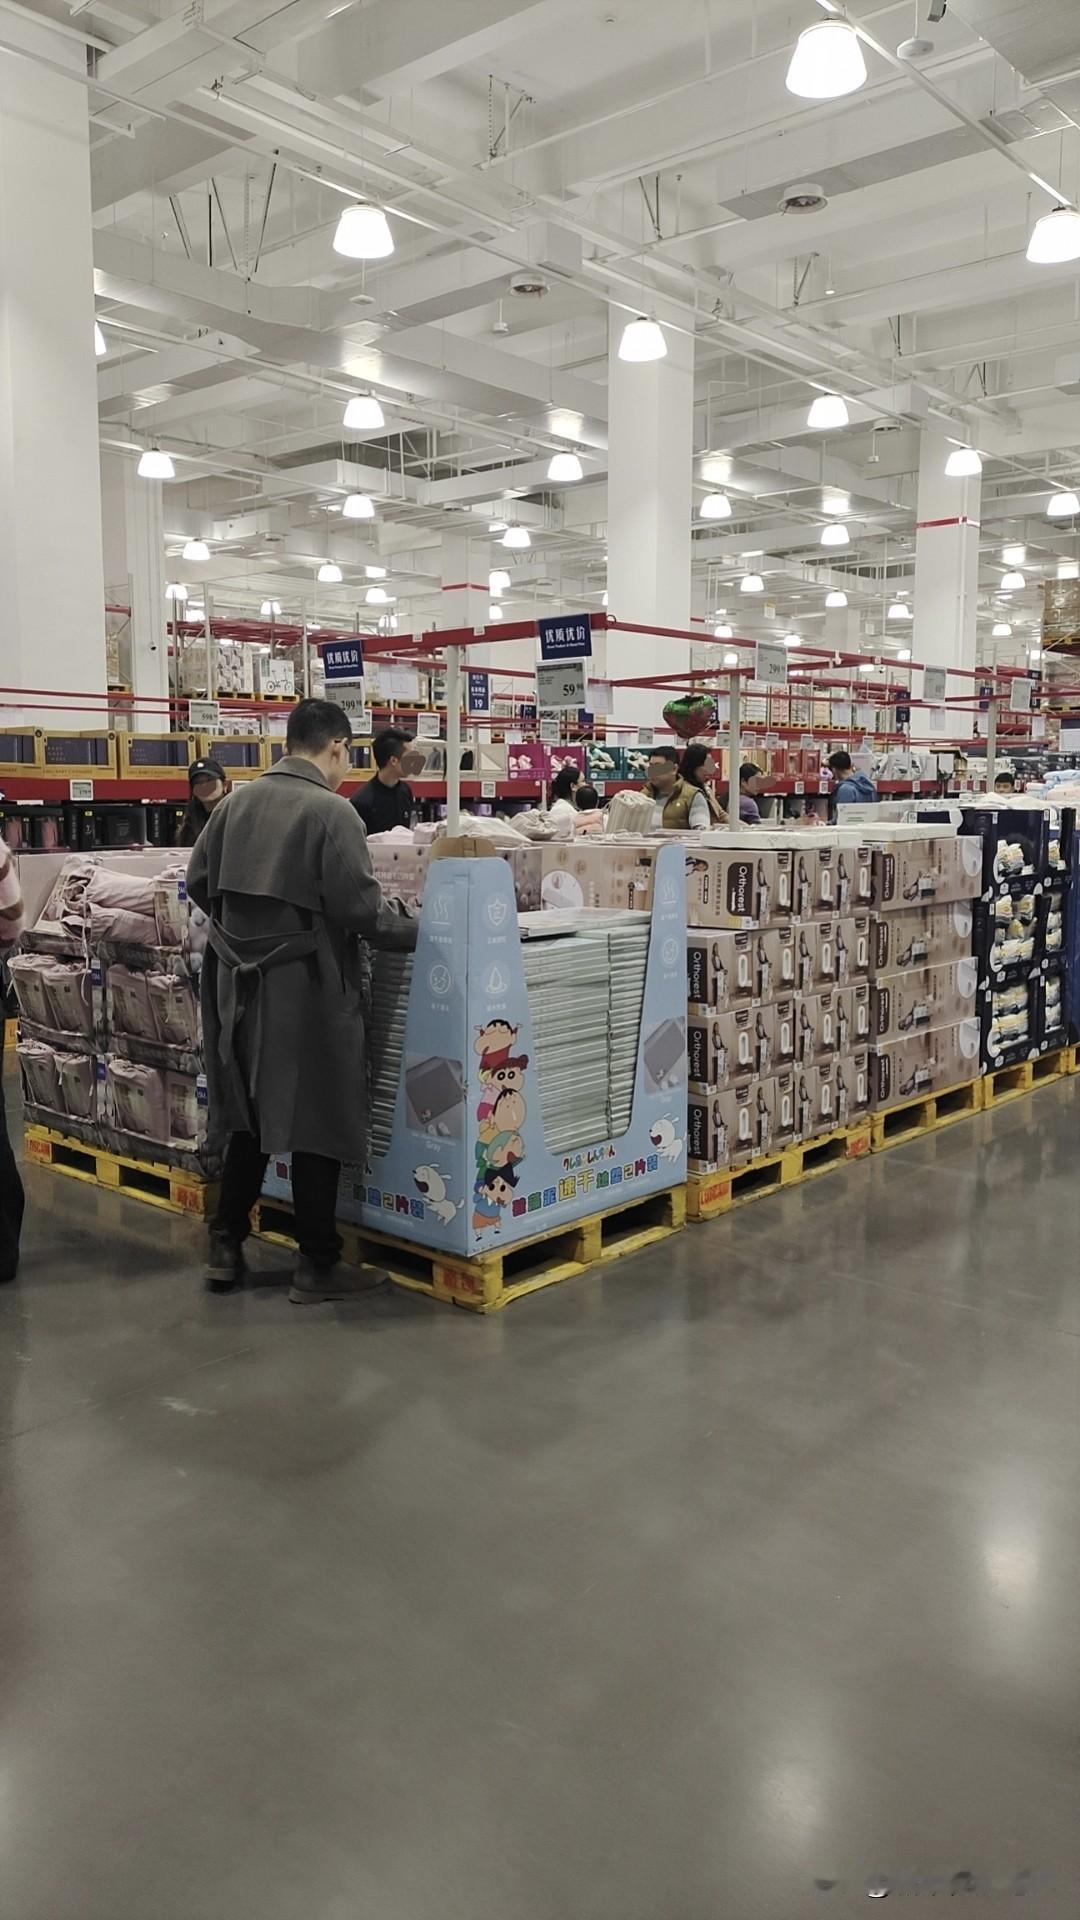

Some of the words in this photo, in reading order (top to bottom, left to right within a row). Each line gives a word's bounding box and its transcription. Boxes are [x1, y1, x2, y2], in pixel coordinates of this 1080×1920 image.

[326, 650, 358, 665] 优质优价
[545, 626, 585, 643] 优质优价
[474, 699, 483, 708] 19
[738, 866, 748, 912] Orthorest
[693, 951, 702, 998] Orthorest
[693, 1031, 702, 1077] Orthorest
[693, 1109, 702, 1155] Orthorest
